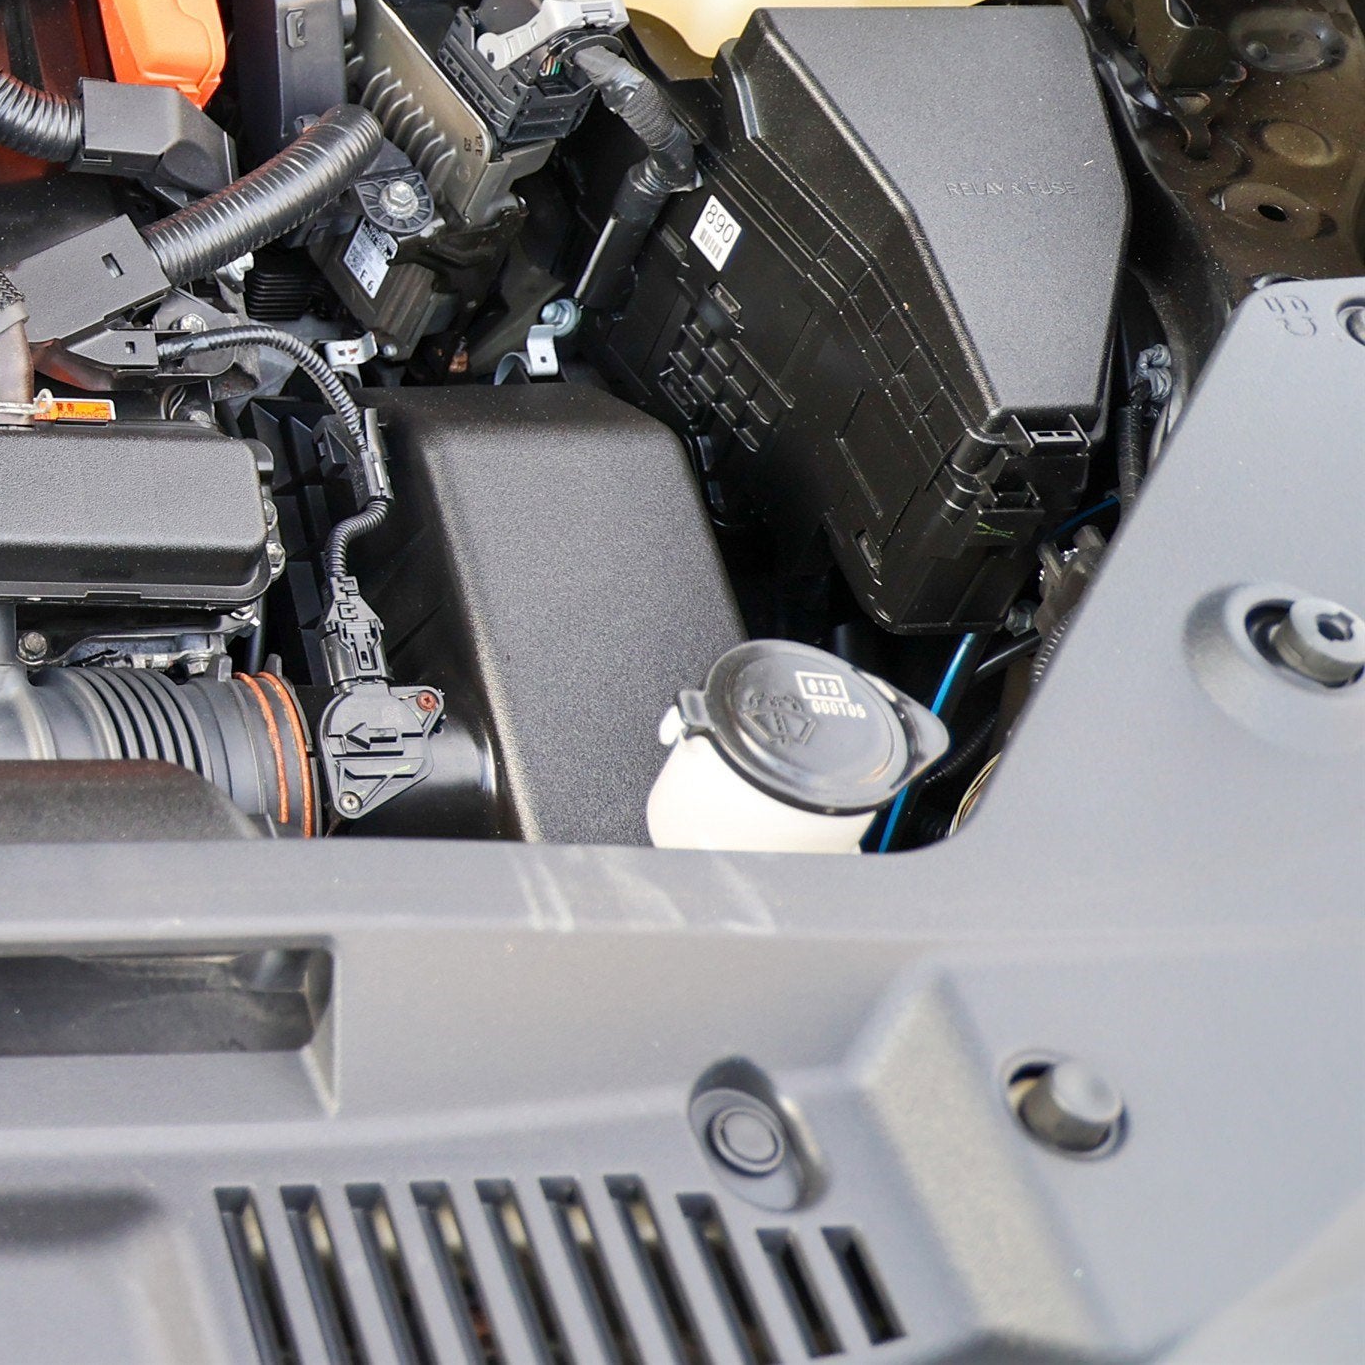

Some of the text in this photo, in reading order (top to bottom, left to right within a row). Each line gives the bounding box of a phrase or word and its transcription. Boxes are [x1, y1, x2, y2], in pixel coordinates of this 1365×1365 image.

[945, 181, 1079, 196] RELAY & FUSE
[704, 204, 736, 243] 890
